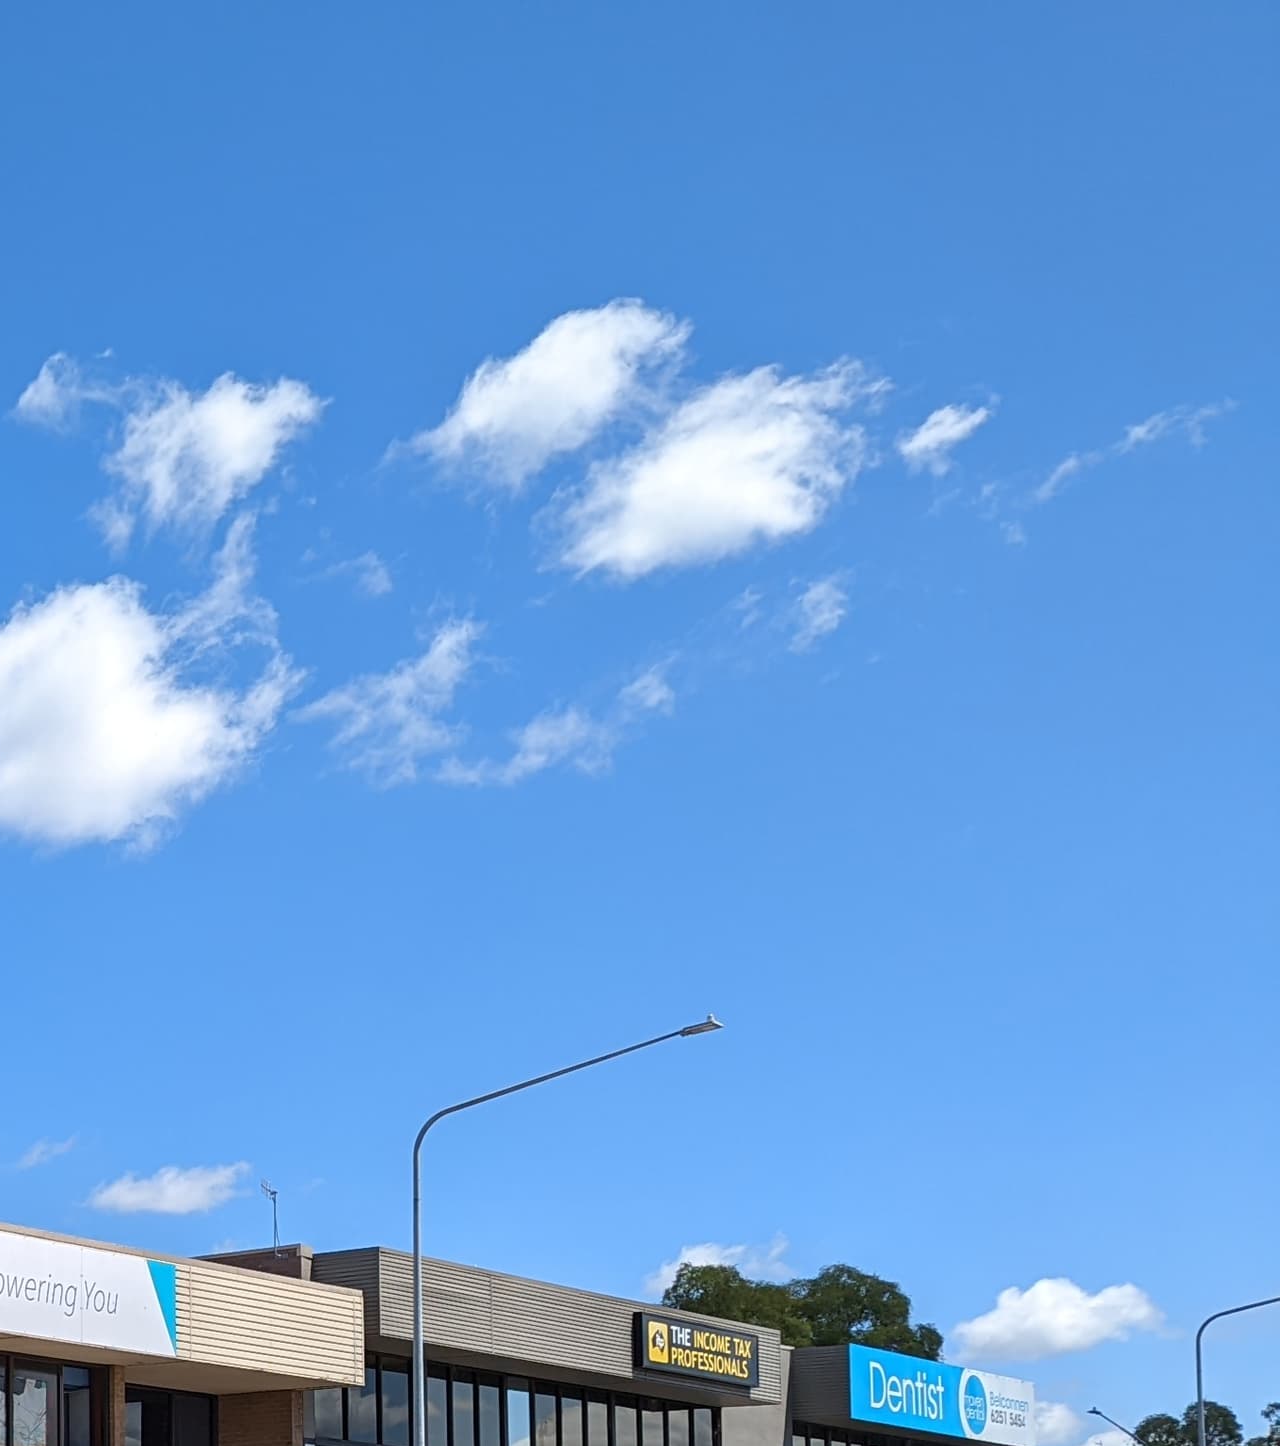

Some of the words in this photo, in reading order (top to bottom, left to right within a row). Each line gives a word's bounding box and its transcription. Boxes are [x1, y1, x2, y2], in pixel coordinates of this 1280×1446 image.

[83, 1279, 119, 1315] You
[670, 1325, 692, 1347] THE
[693, 1330, 732, 1354] INCOME
[733, 1338, 752, 1359] TAX
[671, 1347, 749, 1379] PROFESSIONALS
[868, 1360, 945, 1421] Dentist
[989, 1391, 1029, 1412] Belconnen
[990, 1409, 1008, 1425] 6251
[1009, 1412, 1027, 1428] 5454
